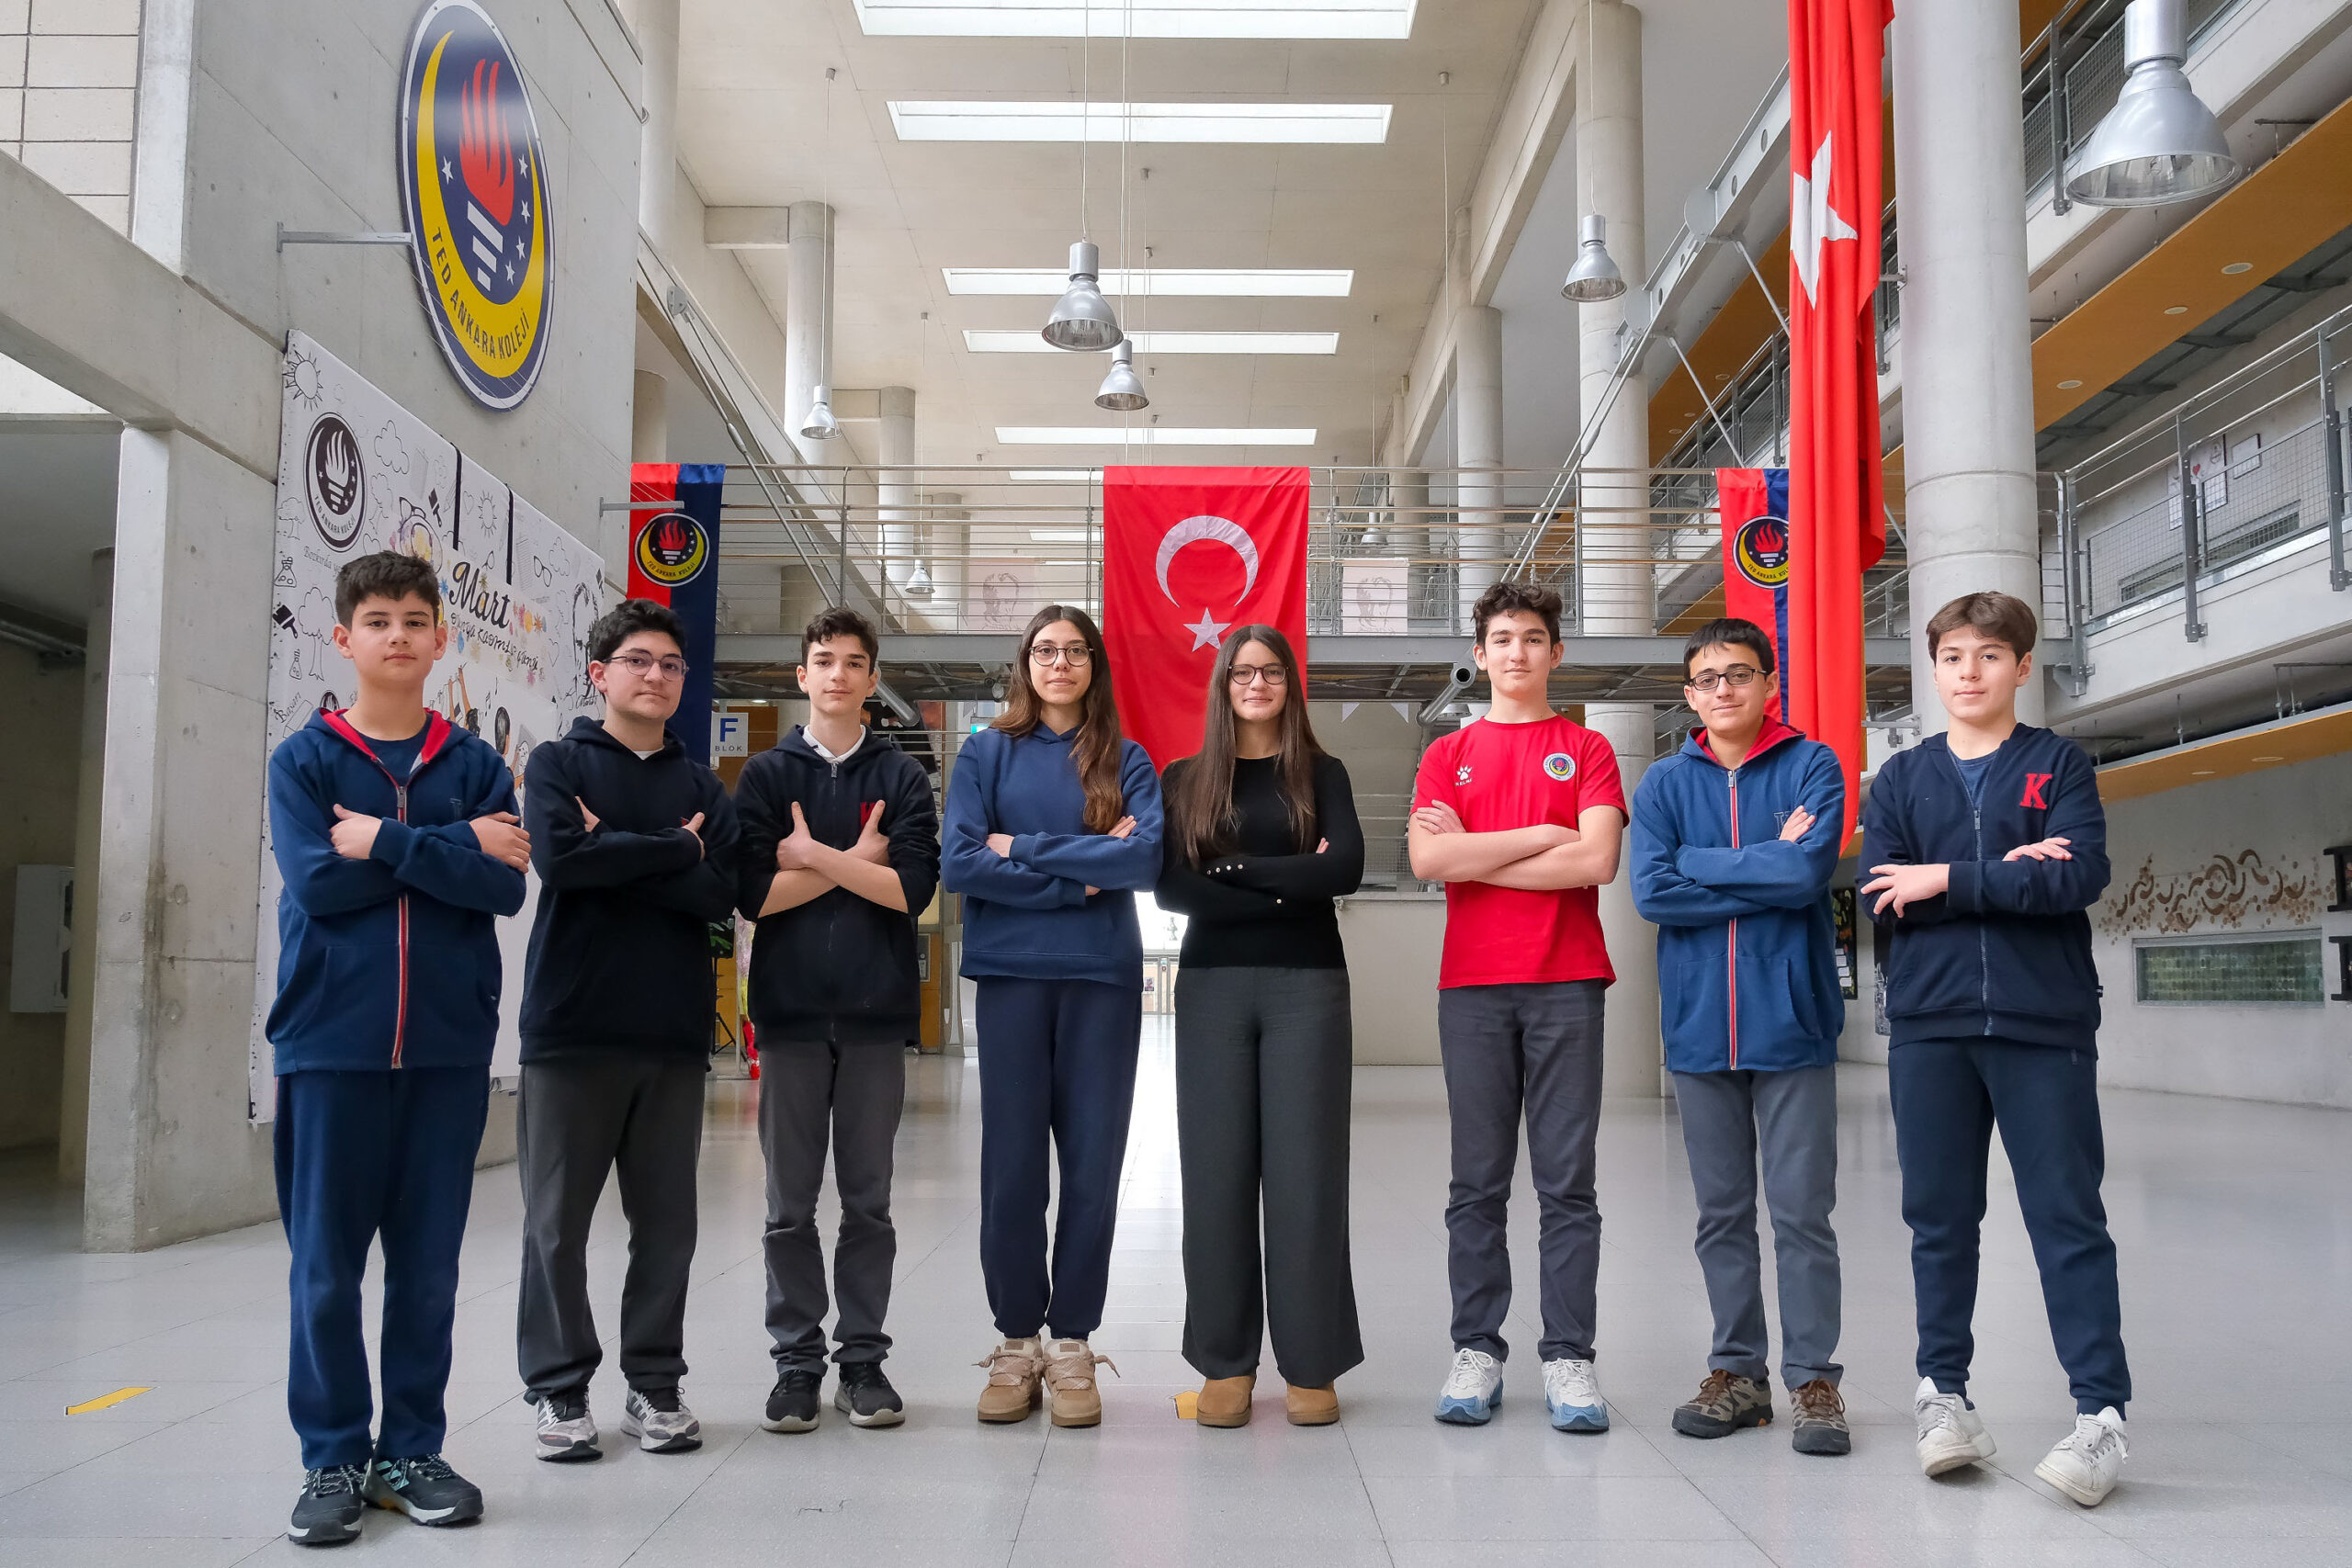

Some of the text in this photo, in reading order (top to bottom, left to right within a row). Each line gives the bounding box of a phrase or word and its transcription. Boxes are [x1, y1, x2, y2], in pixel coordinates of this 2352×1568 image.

[432, 226, 530, 360] TED ANKARA KOLEJİ
[647, 560, 656, 571] TED
[656, 569, 676, 578] ANKARA
[1747, 563, 1789, 580] TED ANKARA KOL
[448, 561, 511, 629] Mart
[719, 717, 739, 742] F
[2018, 773, 2053, 809] K
